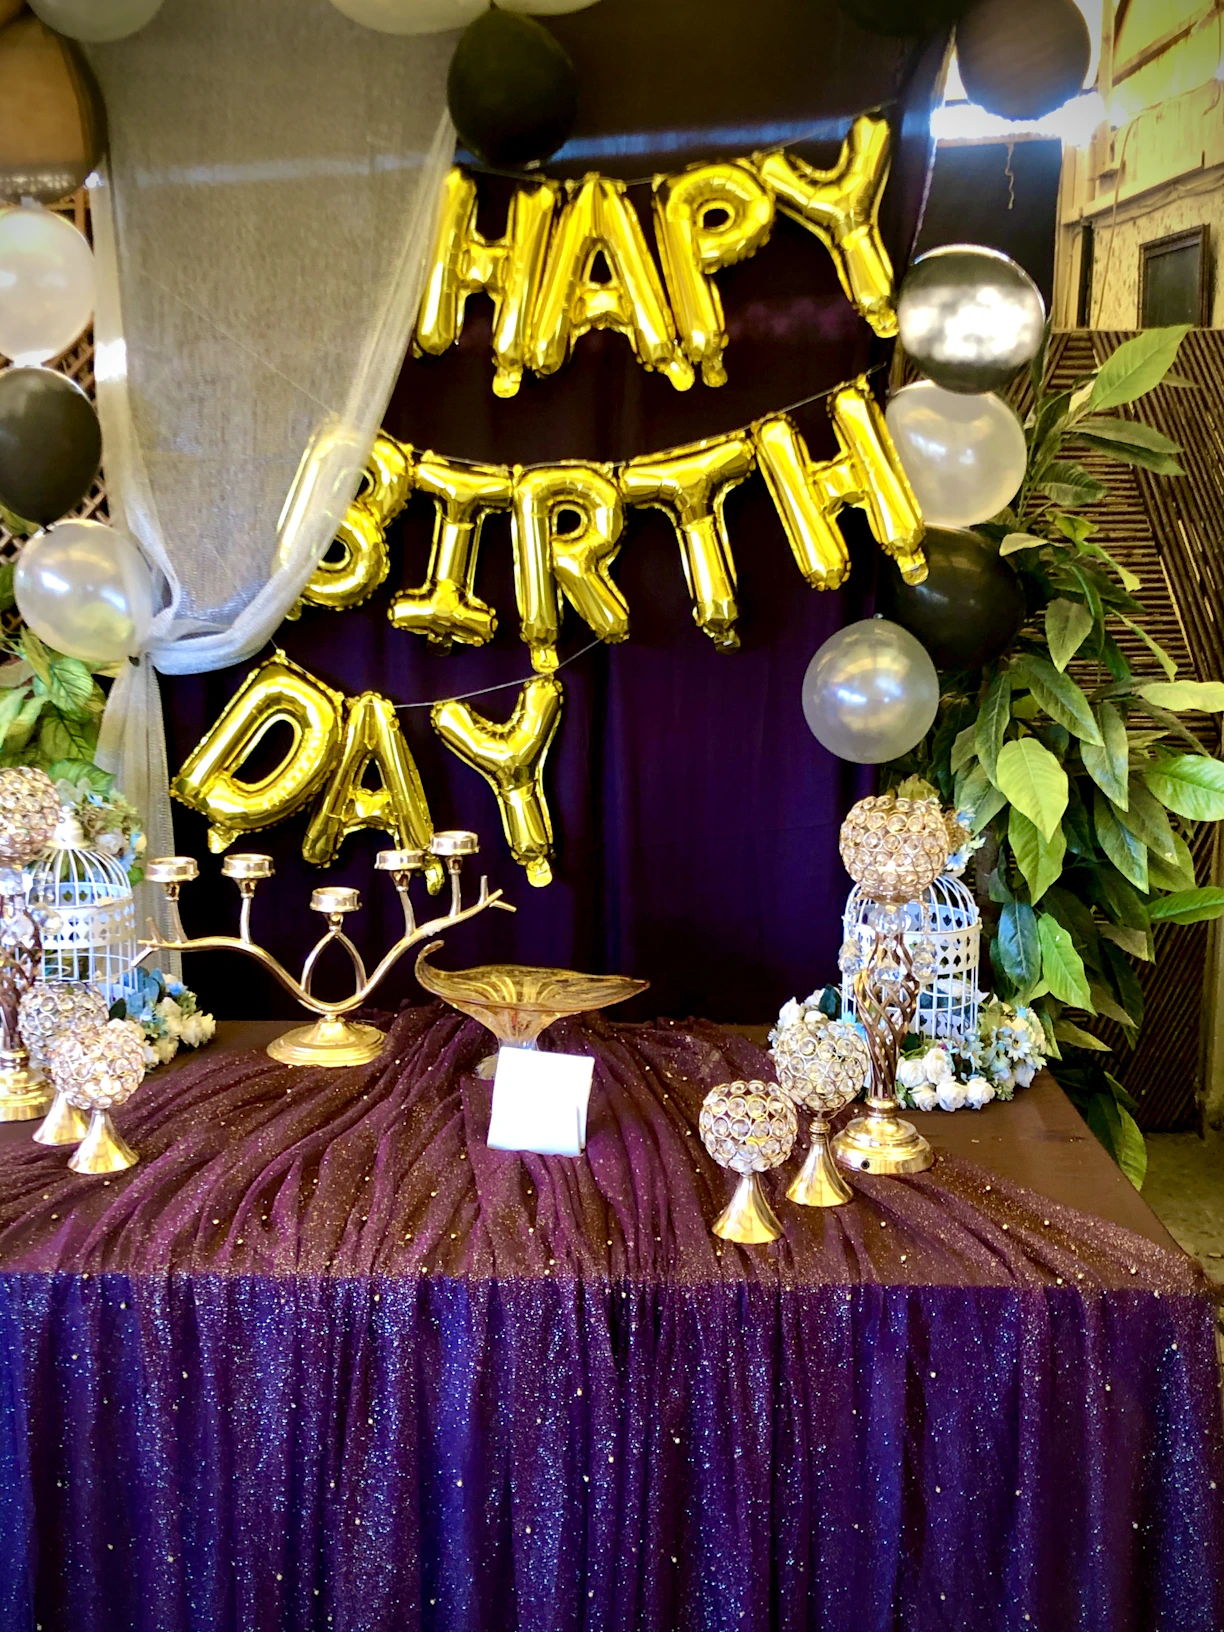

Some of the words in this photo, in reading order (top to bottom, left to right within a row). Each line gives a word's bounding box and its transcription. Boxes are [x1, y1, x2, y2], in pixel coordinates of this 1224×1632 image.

[414, 114, 899, 396] HAPY
[274, 376, 927, 668] BIRTH
[170, 651, 563, 892] DAY
